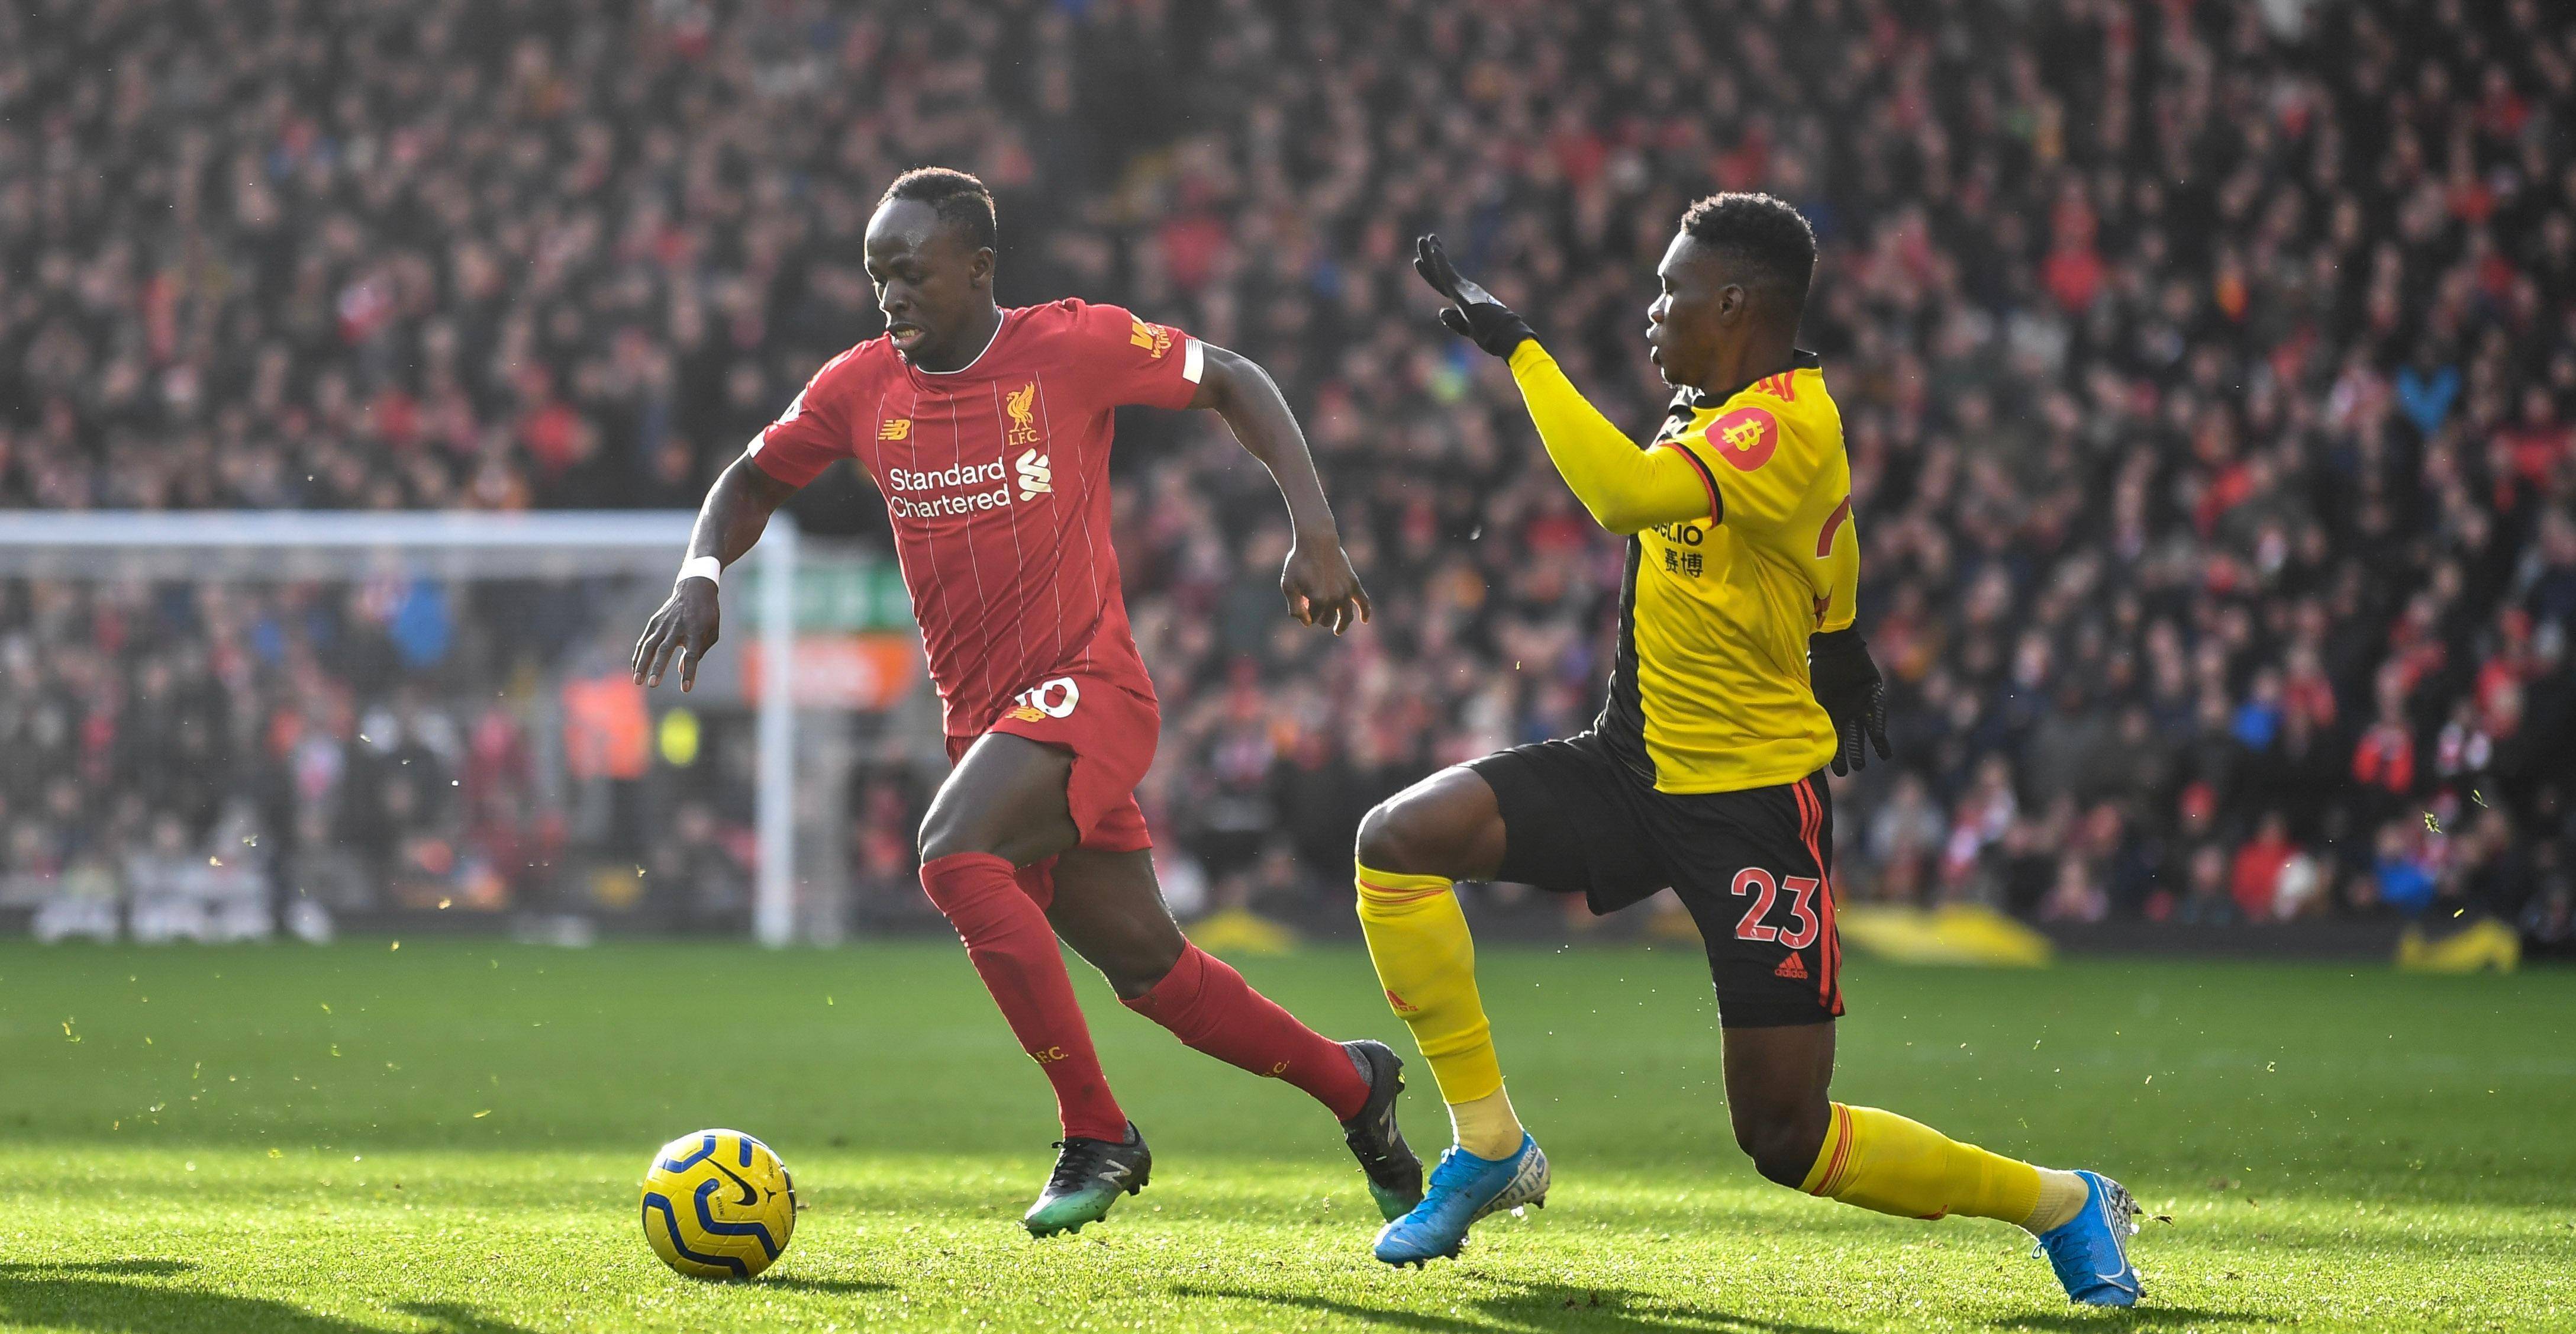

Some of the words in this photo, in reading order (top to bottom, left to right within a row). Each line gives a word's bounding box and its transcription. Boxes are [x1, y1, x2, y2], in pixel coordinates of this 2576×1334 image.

[1008, 429, 1041, 446] L.F.C.
[890, 456, 1006, 491] Standard
[891, 483, 1011, 518] Chartered
[1731, 866, 1820, 949] 23
